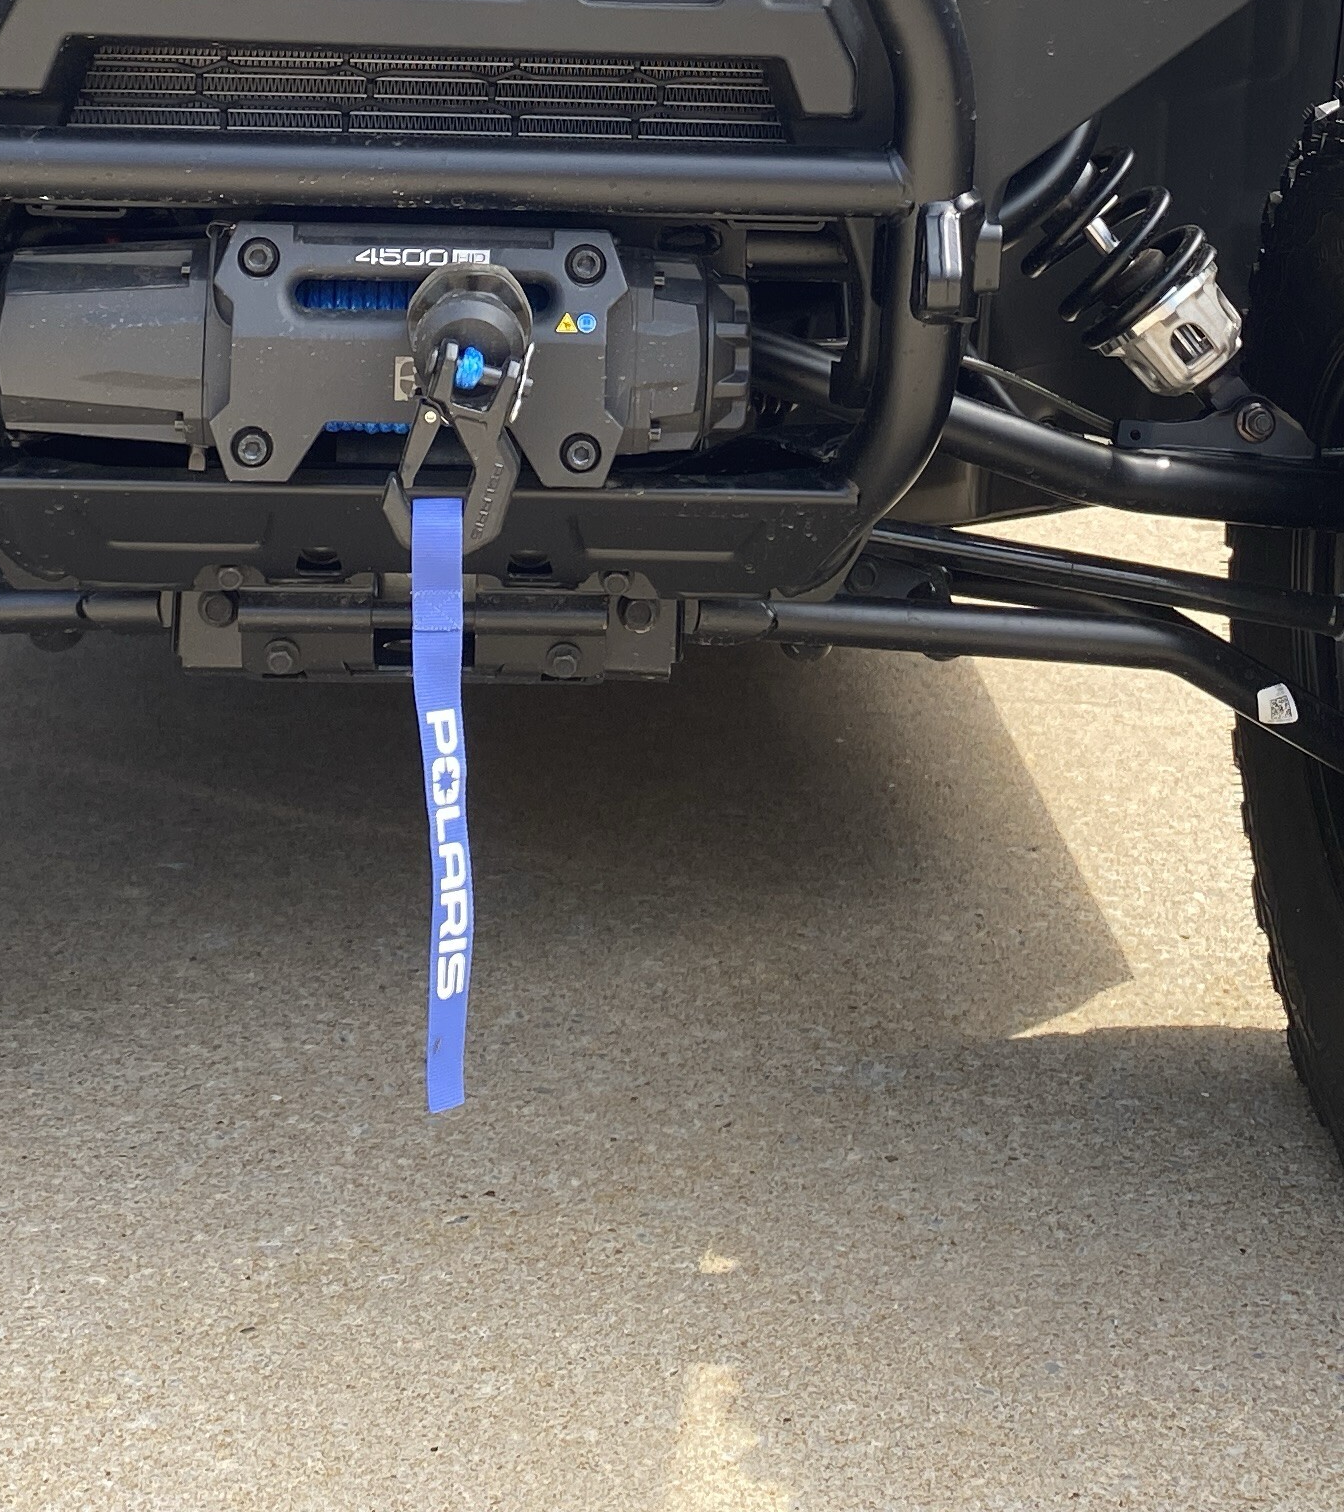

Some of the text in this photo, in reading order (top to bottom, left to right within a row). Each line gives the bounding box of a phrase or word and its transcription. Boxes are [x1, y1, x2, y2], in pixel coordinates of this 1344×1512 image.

[355, 247, 489, 267] 4500 HD
[424, 707, 471, 1002] POLARIS
